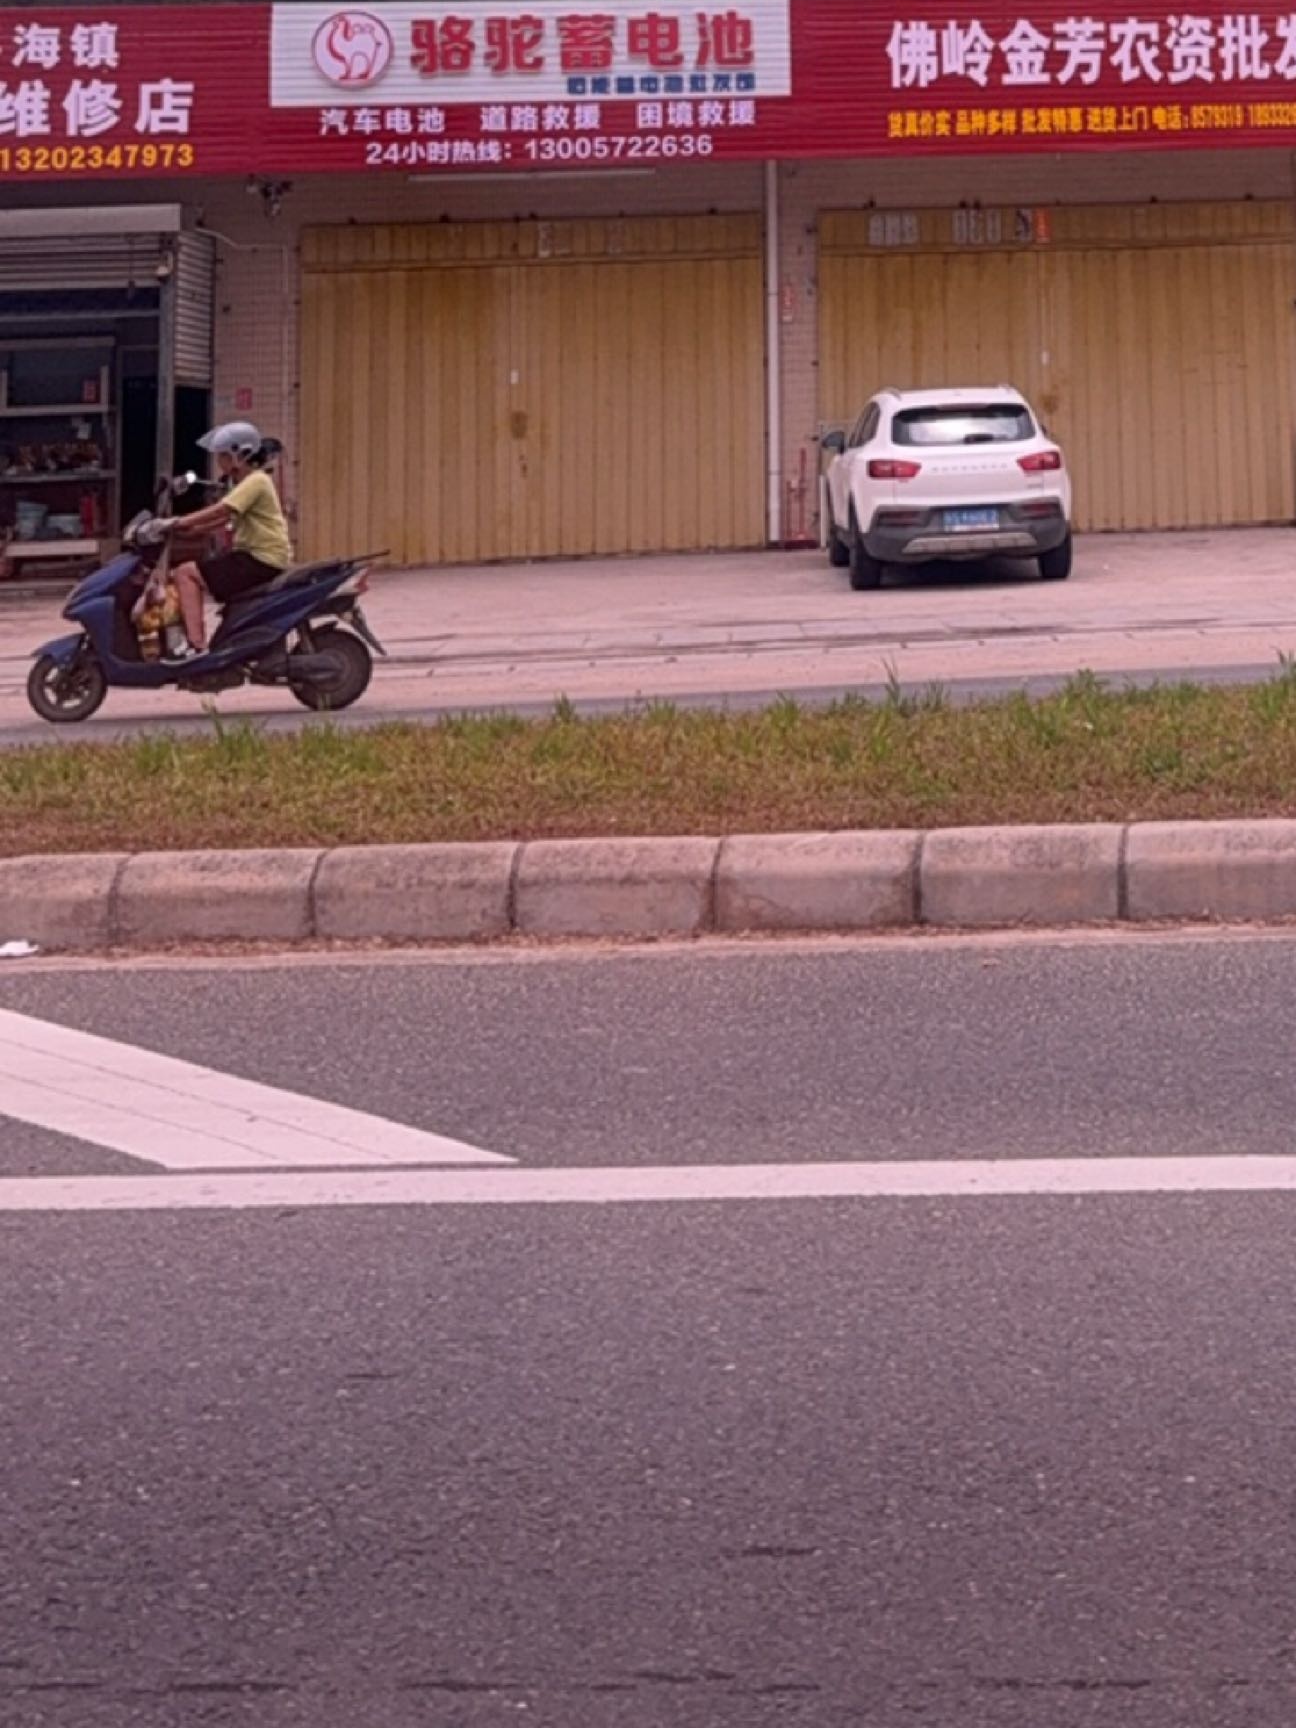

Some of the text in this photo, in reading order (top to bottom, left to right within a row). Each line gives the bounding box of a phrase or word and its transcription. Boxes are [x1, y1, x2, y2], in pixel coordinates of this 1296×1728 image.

[0, 22, 120, 70] 海镇
[410, 10, 756, 74] 骆驼蓄电池
[0, 78, 194, 136] 维修店
[319, 108, 446, 135] 汽车电池
[480, 104, 600, 131] 道路救援
[0, 144, 194, 171] 13202347973
